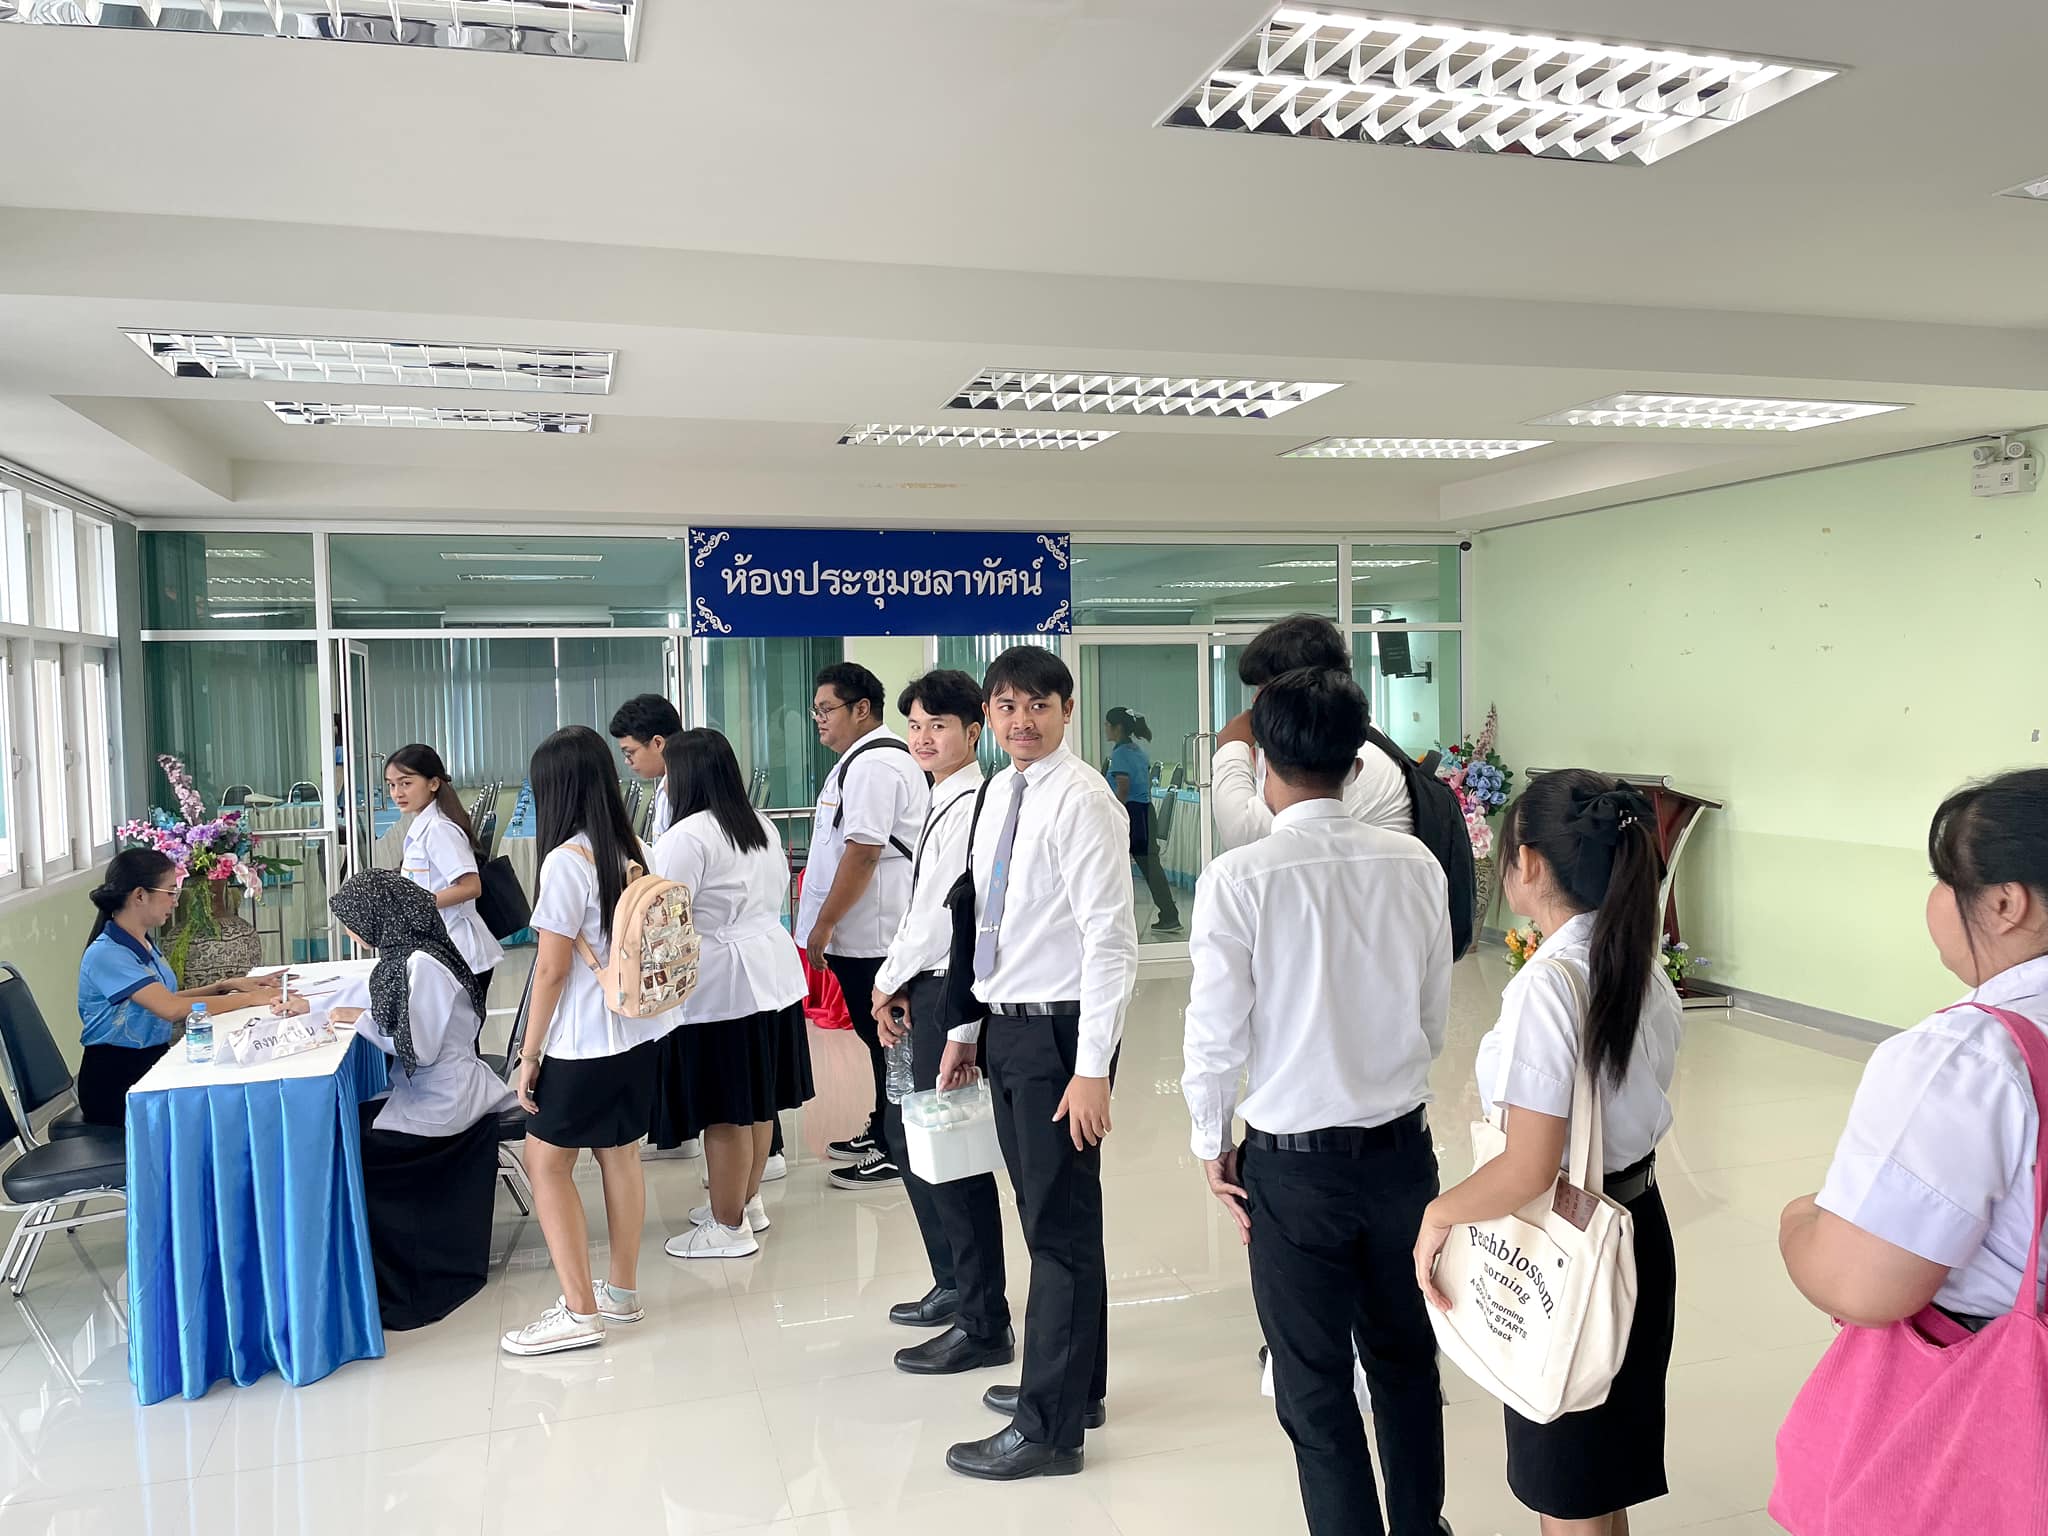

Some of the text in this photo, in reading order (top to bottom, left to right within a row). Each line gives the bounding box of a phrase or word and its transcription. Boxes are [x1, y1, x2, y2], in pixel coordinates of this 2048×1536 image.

[721, 553, 1044, 609] ห้องประชุมชลาทัศน์
